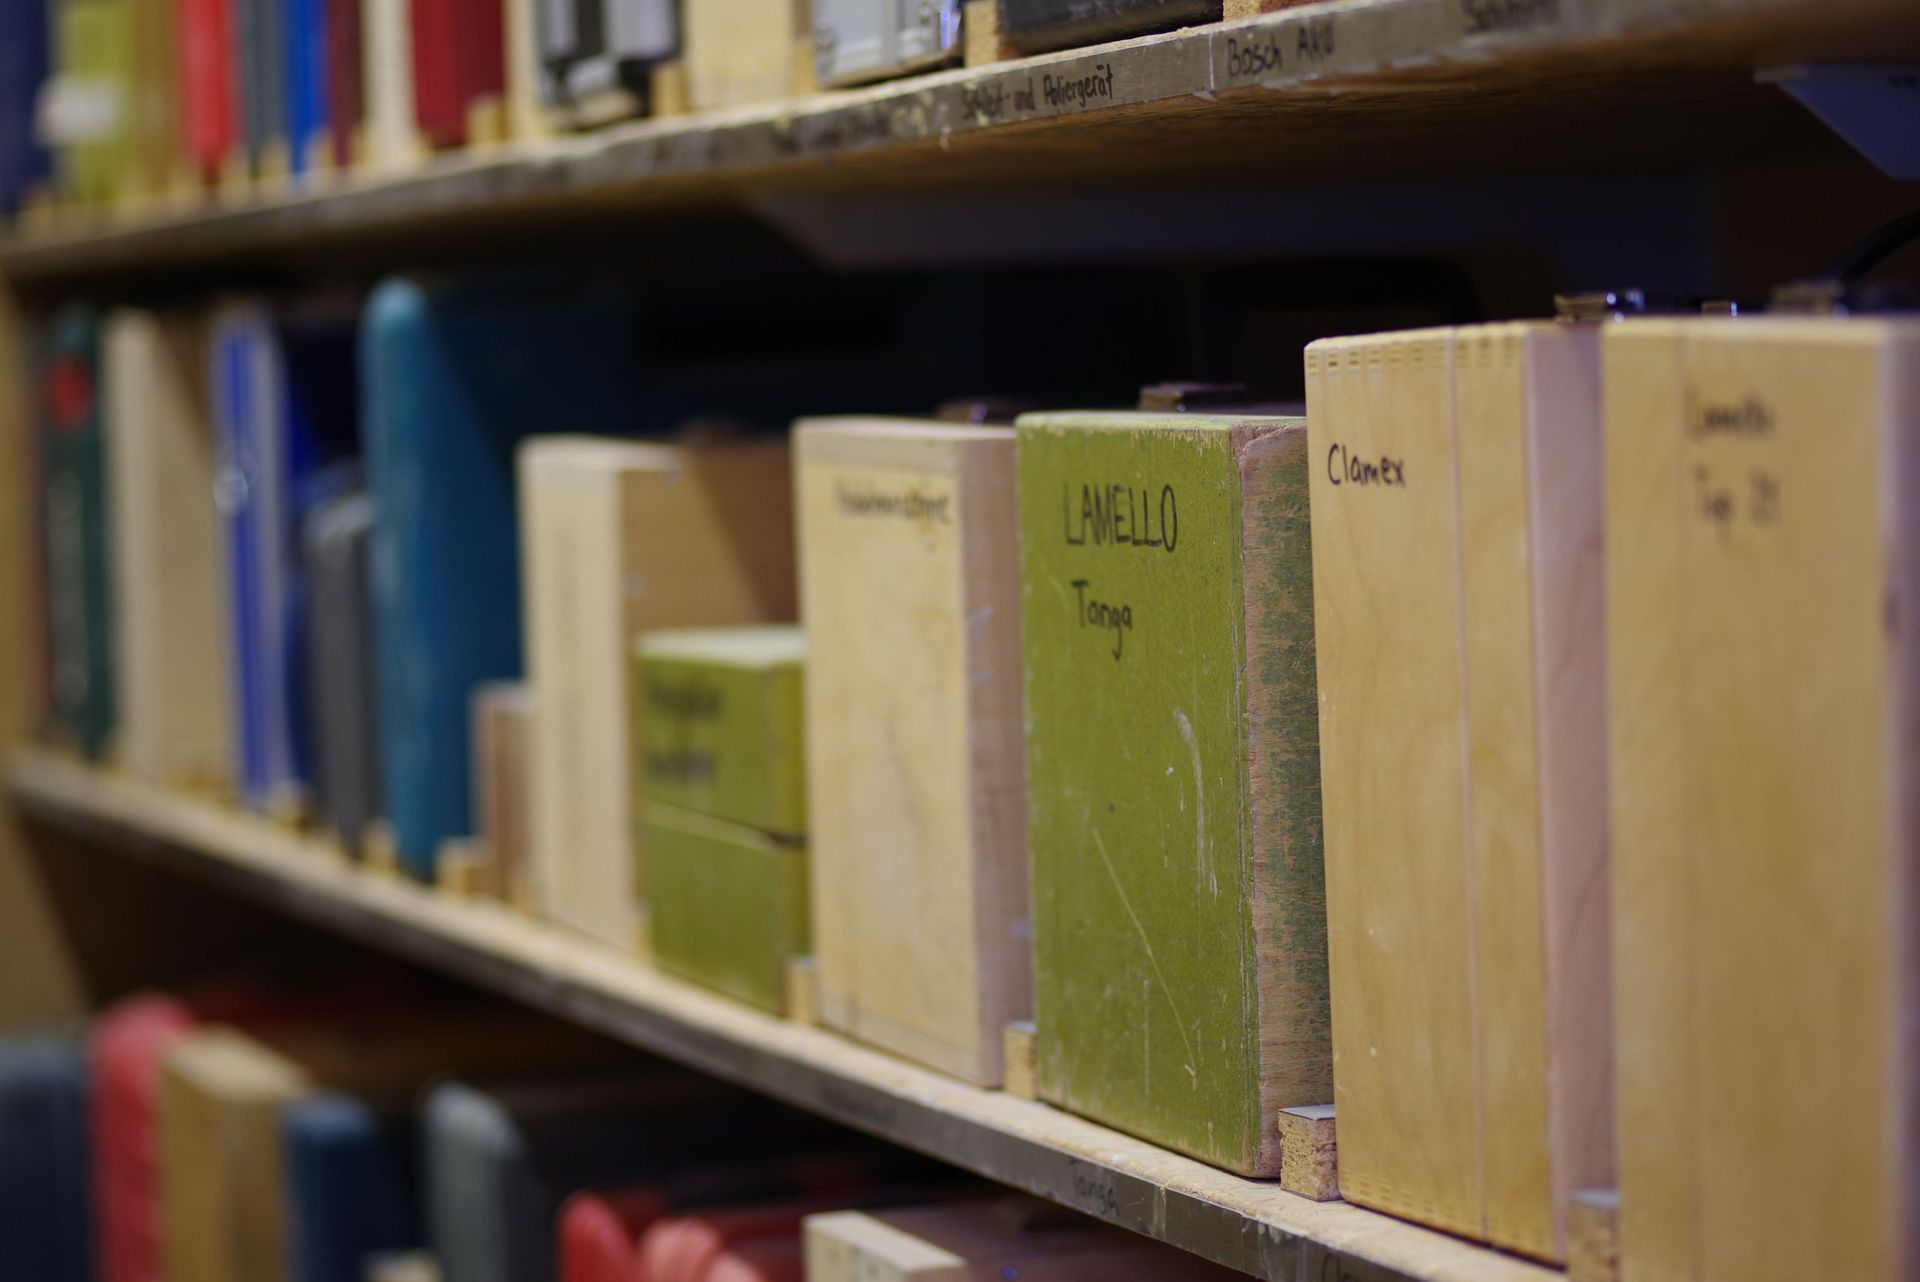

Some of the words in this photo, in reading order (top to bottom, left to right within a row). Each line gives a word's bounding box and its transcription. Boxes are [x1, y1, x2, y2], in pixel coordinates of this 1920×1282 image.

[1227, 31, 1282, 77] Bosch
[1043, 63, 1114, 107] Poliergerät
[1328, 443, 1406, 488] Clamex
[1064, 482, 1177, 553] LAMELLO
[1071, 578, 1132, 661] Tanga
